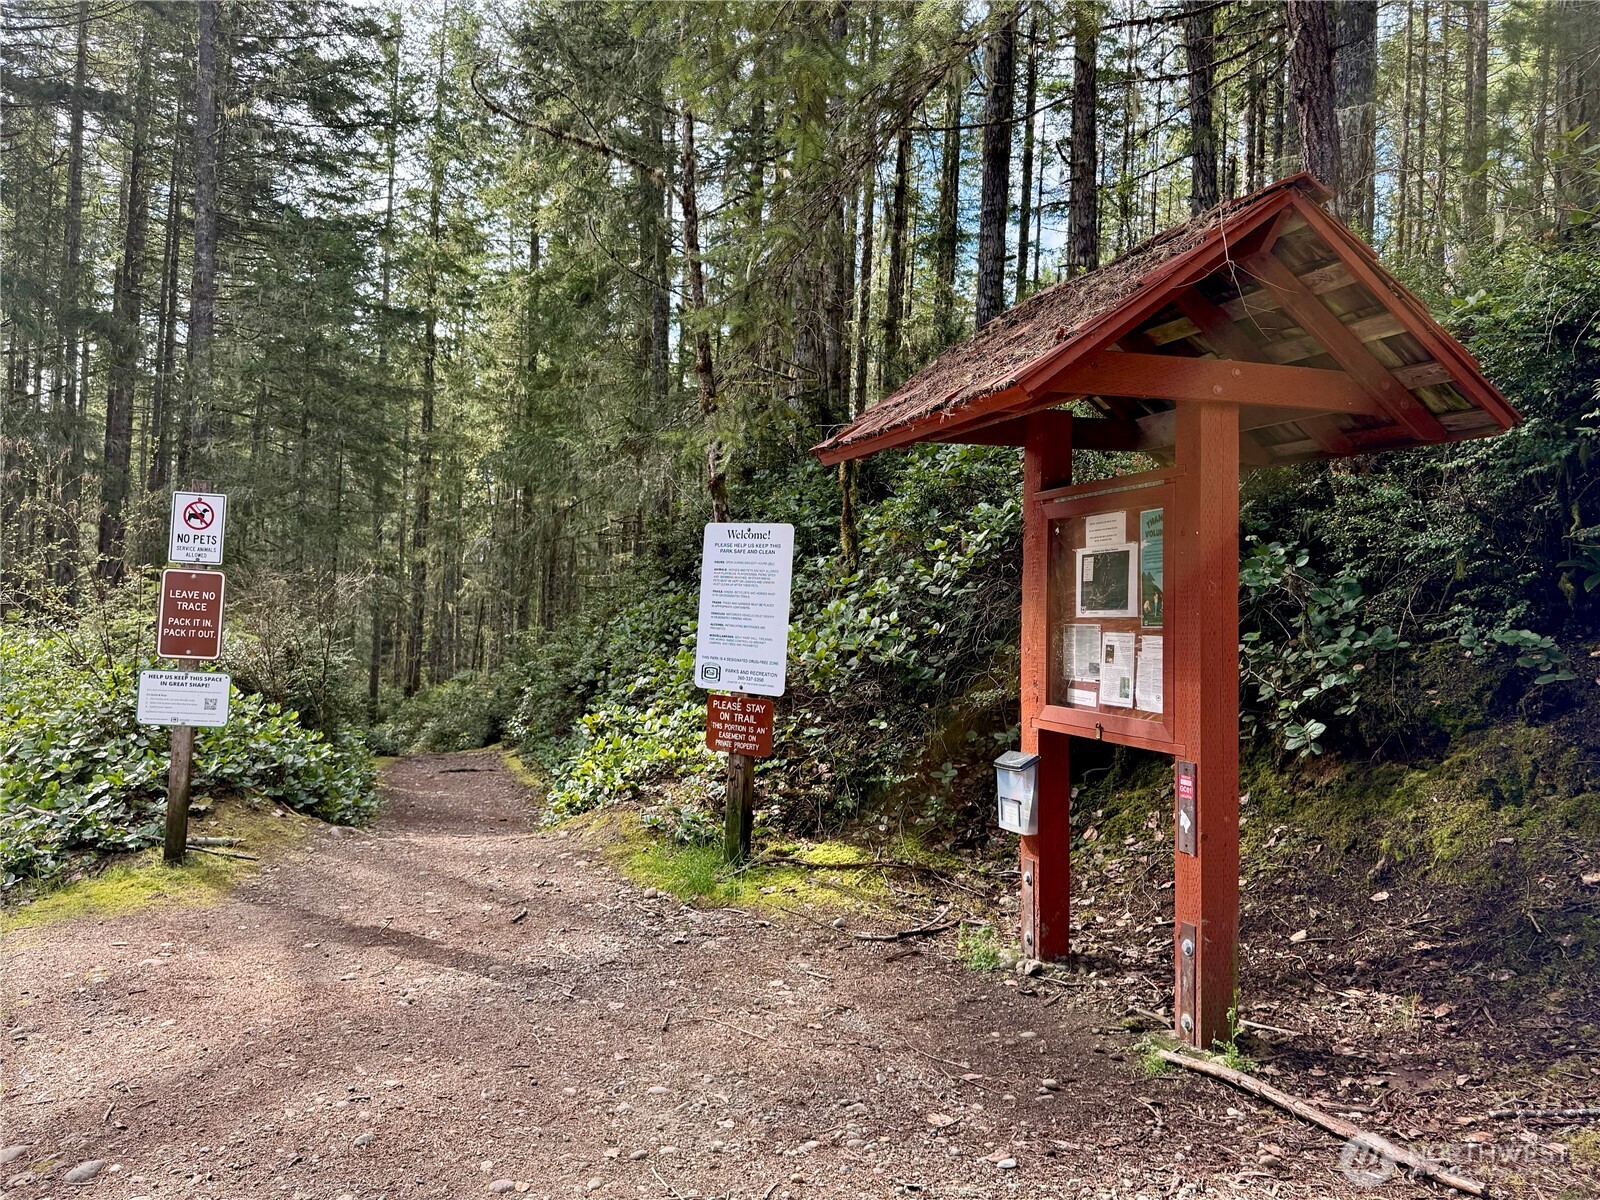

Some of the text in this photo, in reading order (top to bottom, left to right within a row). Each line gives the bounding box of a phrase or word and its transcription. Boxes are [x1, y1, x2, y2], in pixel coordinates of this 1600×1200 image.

[727, 530, 770, 539] Welcome!
[177, 534, 217, 545] NO PETS
[169, 590, 216, 600] LEAVE NO
[177, 602, 207, 611] TRACE
[168, 618, 191, 626] PACK
[713, 700, 766, 713] PLEASE STAY
[720, 712, 756, 724] ON TRAIL
[725, 724, 746, 732] PORTION
[719, 732, 746, 740] EASEMENT
[715, 739, 759, 750] PRIVATE PROPERTY
